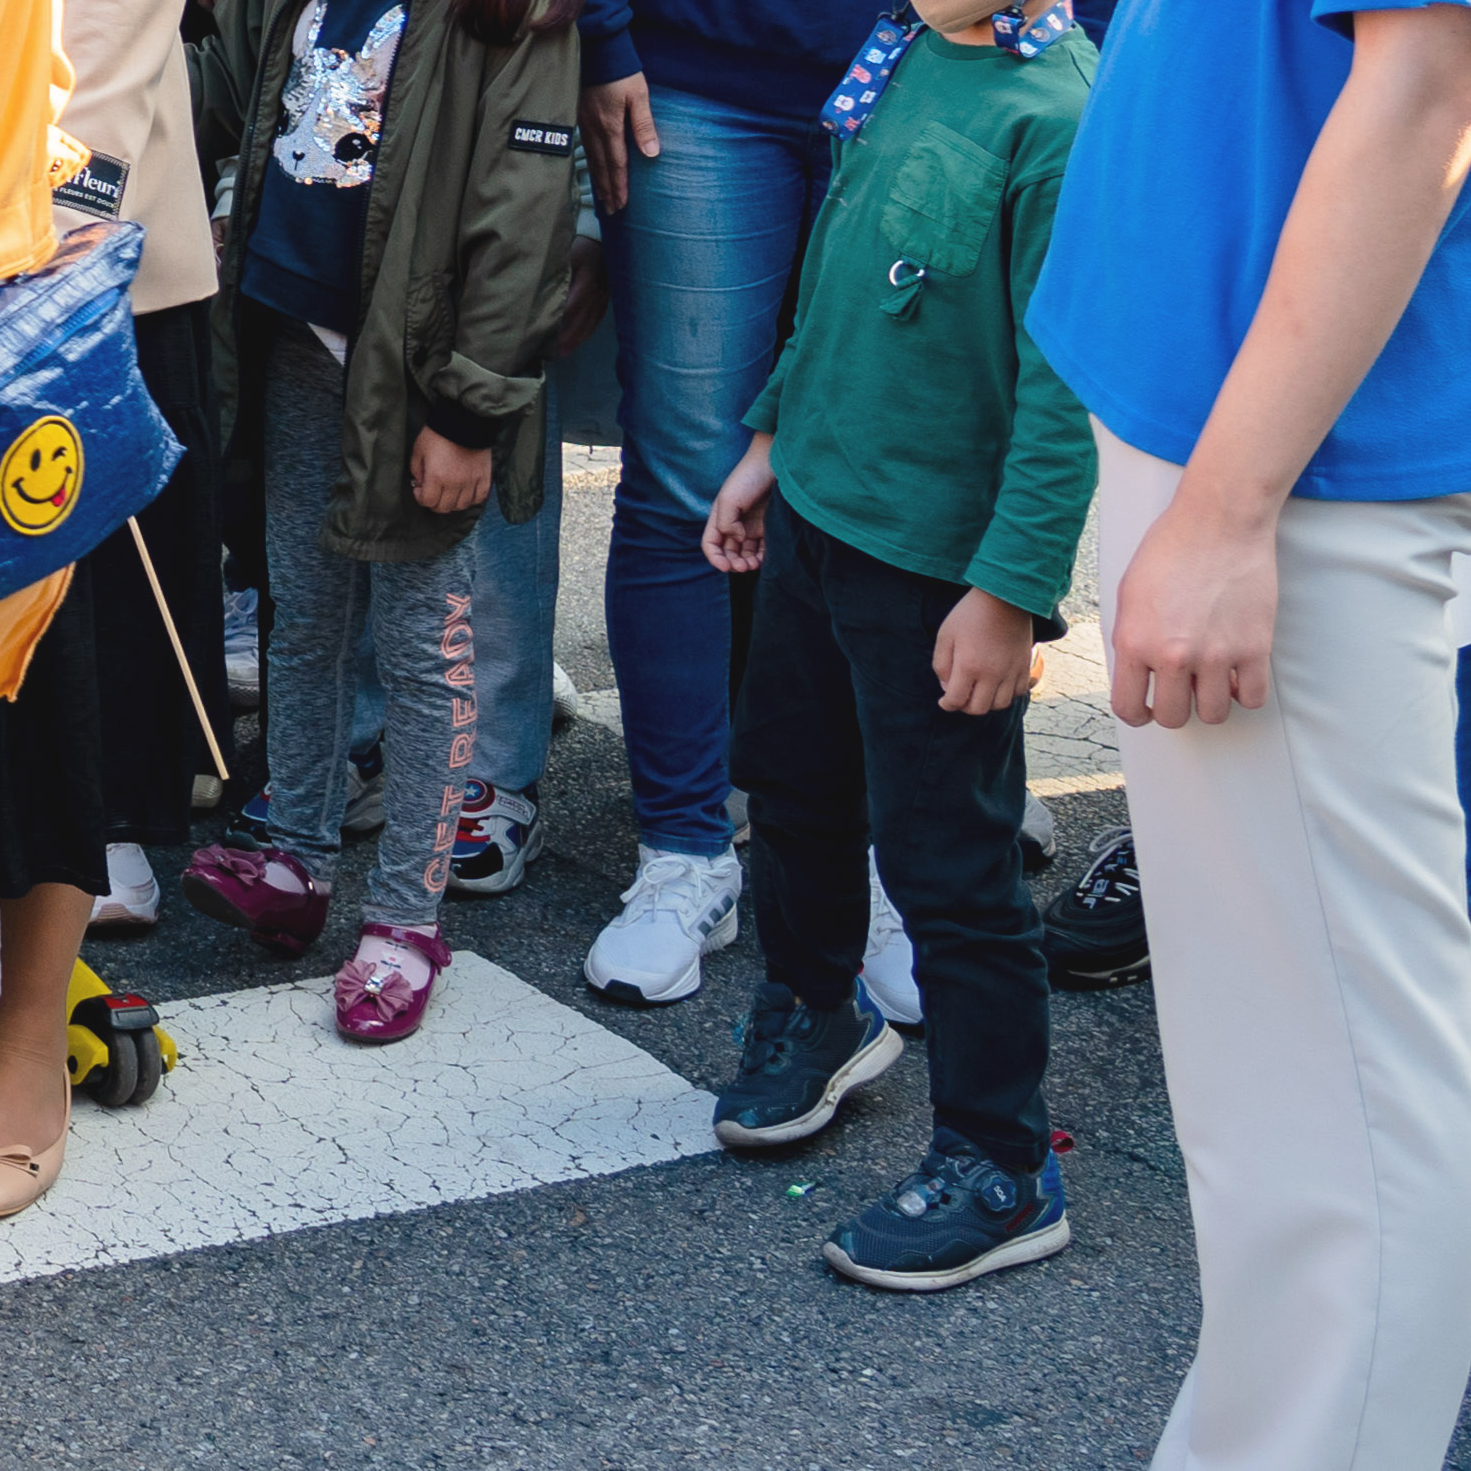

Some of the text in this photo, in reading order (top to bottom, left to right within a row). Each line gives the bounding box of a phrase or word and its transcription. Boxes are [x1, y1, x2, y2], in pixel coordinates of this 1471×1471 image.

[514, 127, 569, 146] CMCR KIDS
[423, 592, 479, 893] GET READY
